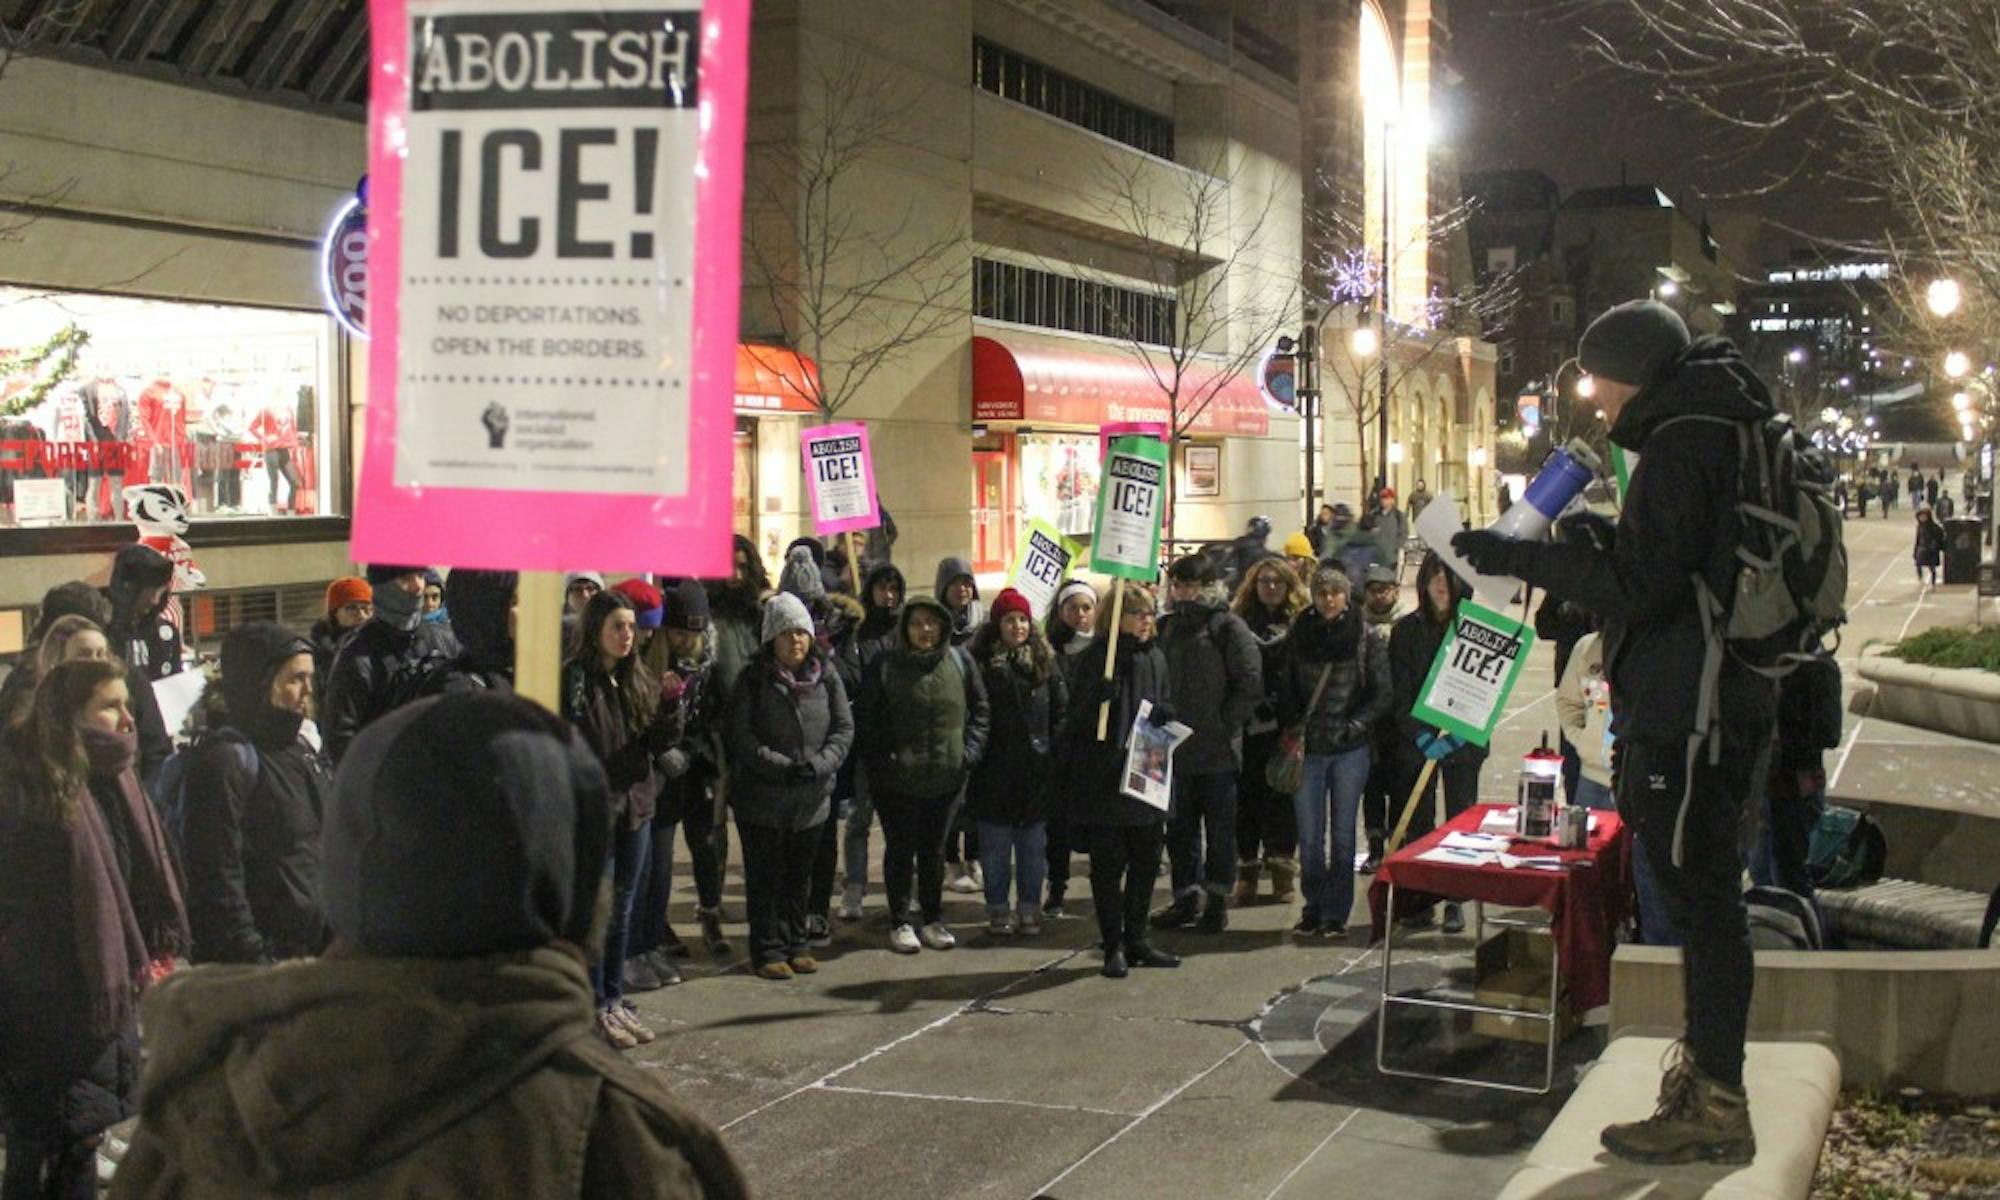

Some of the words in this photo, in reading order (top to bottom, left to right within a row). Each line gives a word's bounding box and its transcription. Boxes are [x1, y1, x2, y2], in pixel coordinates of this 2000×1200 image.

[420, 30, 689, 92] ABOLISH
[437, 127, 660, 259] ICE!
[437, 304, 469, 323] NO
[431, 336, 490, 356] OPEN
[496, 337, 535, 356] THE
[812, 438, 860, 455] ABOLISH
[818, 455, 859, 482] ICE!
[1113, 481, 1154, 518] ICE!
[1025, 549, 1061, 588] ICE!
[1452, 643, 1505, 685] ICE!
